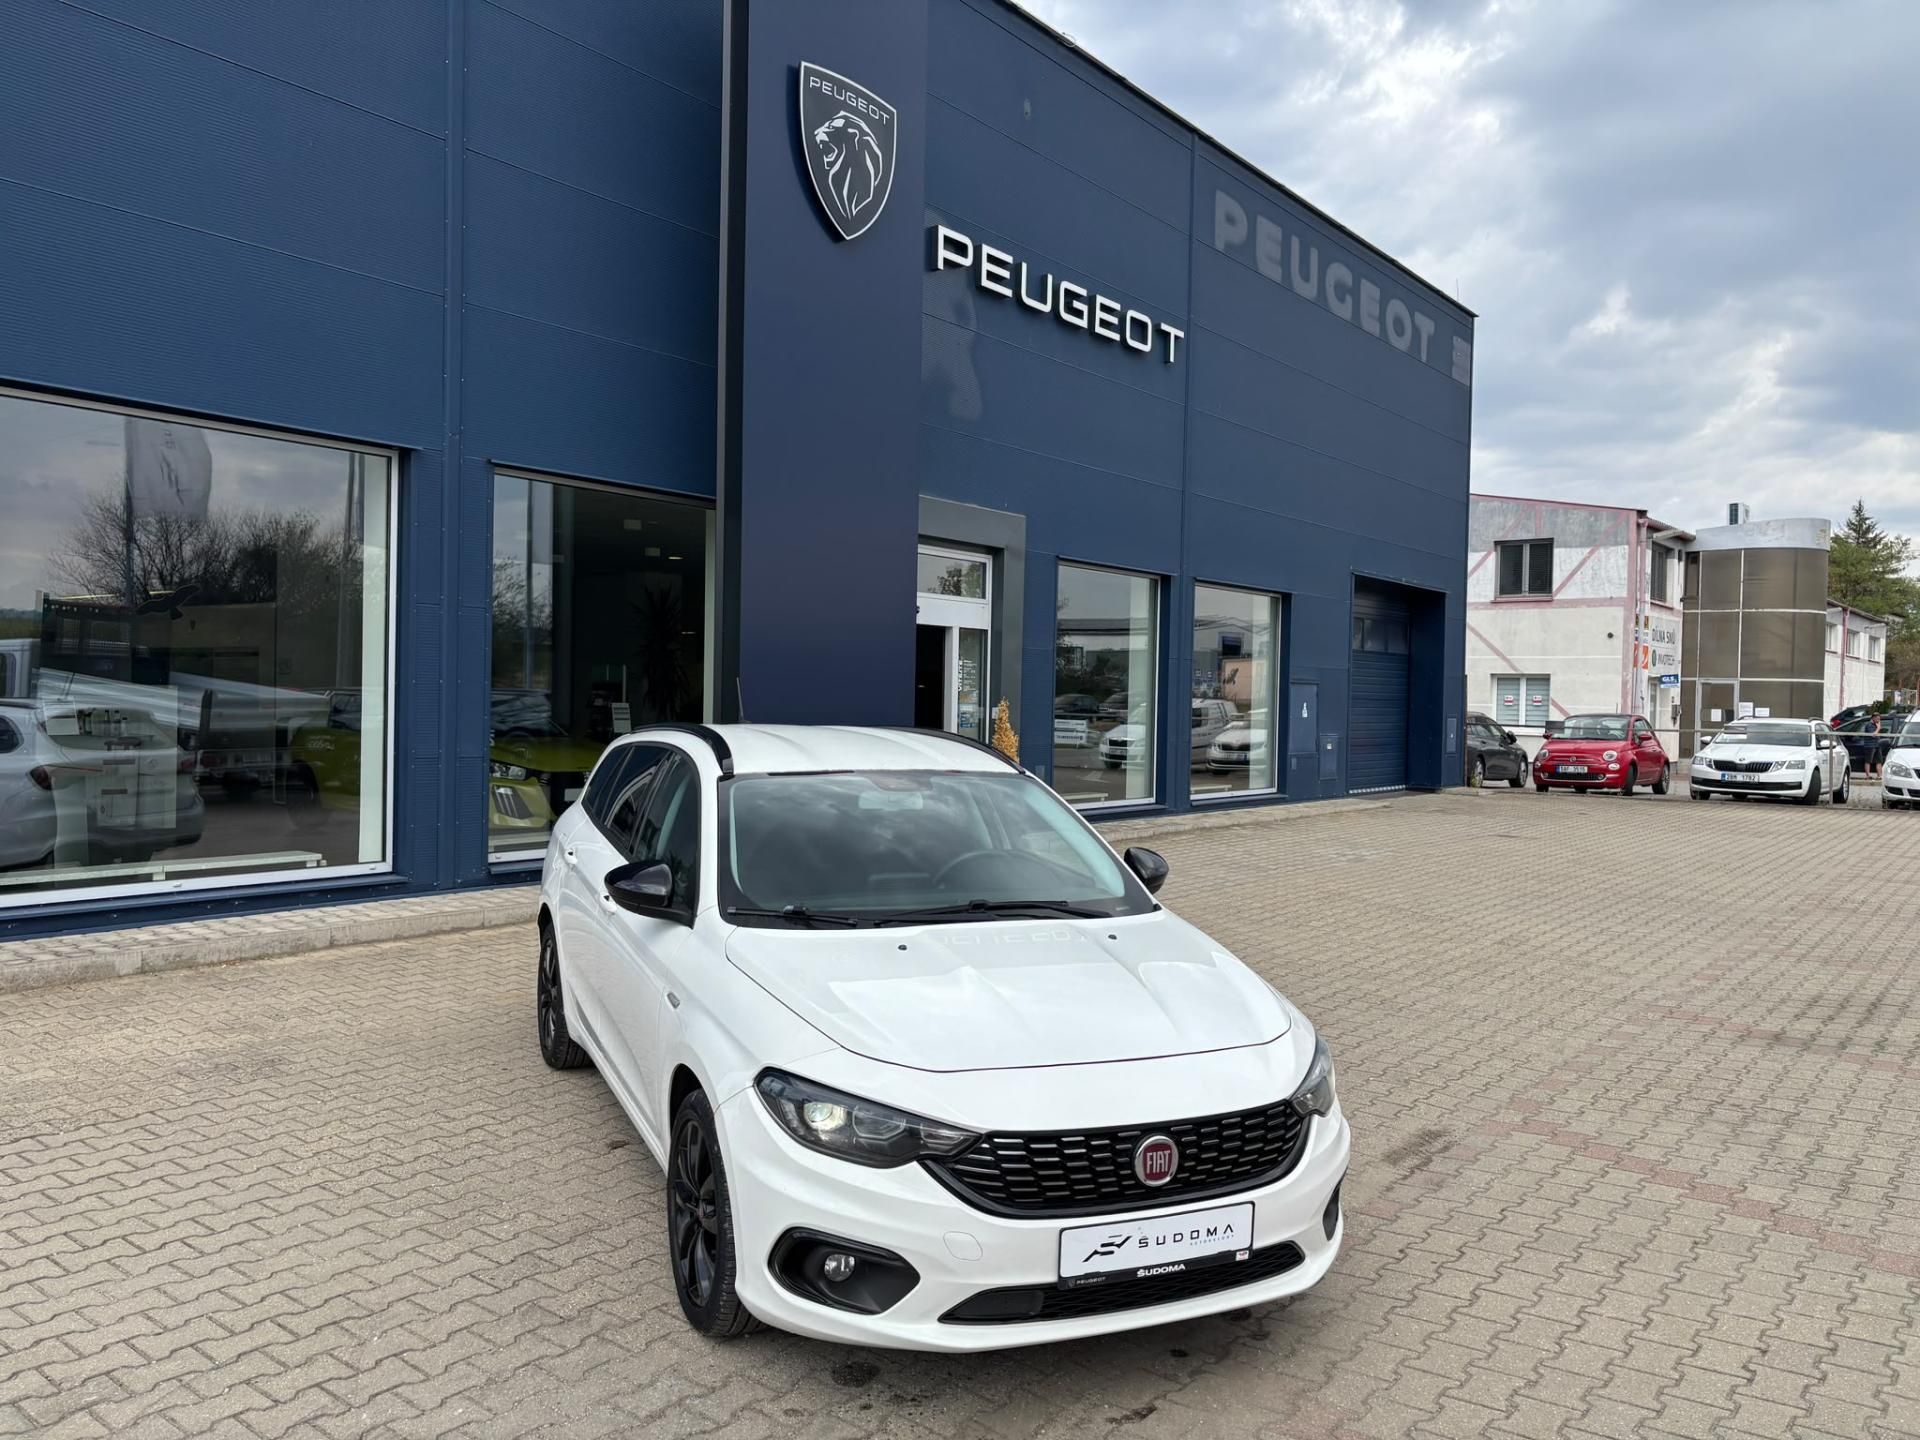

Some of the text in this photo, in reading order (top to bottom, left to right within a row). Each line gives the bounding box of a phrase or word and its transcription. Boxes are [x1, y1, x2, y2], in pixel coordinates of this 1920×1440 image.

[809, 76, 890, 125] PEUGEOT
[935, 224, 1185, 363] PEUGEOT
[1214, 190, 1435, 363] PEUGEOT
[1146, 1150, 1171, 1174] FIAT
[1076, 1276, 1107, 1285] PEUGEOT
[1136, 1262, 1186, 1279] ŠUDOMA
